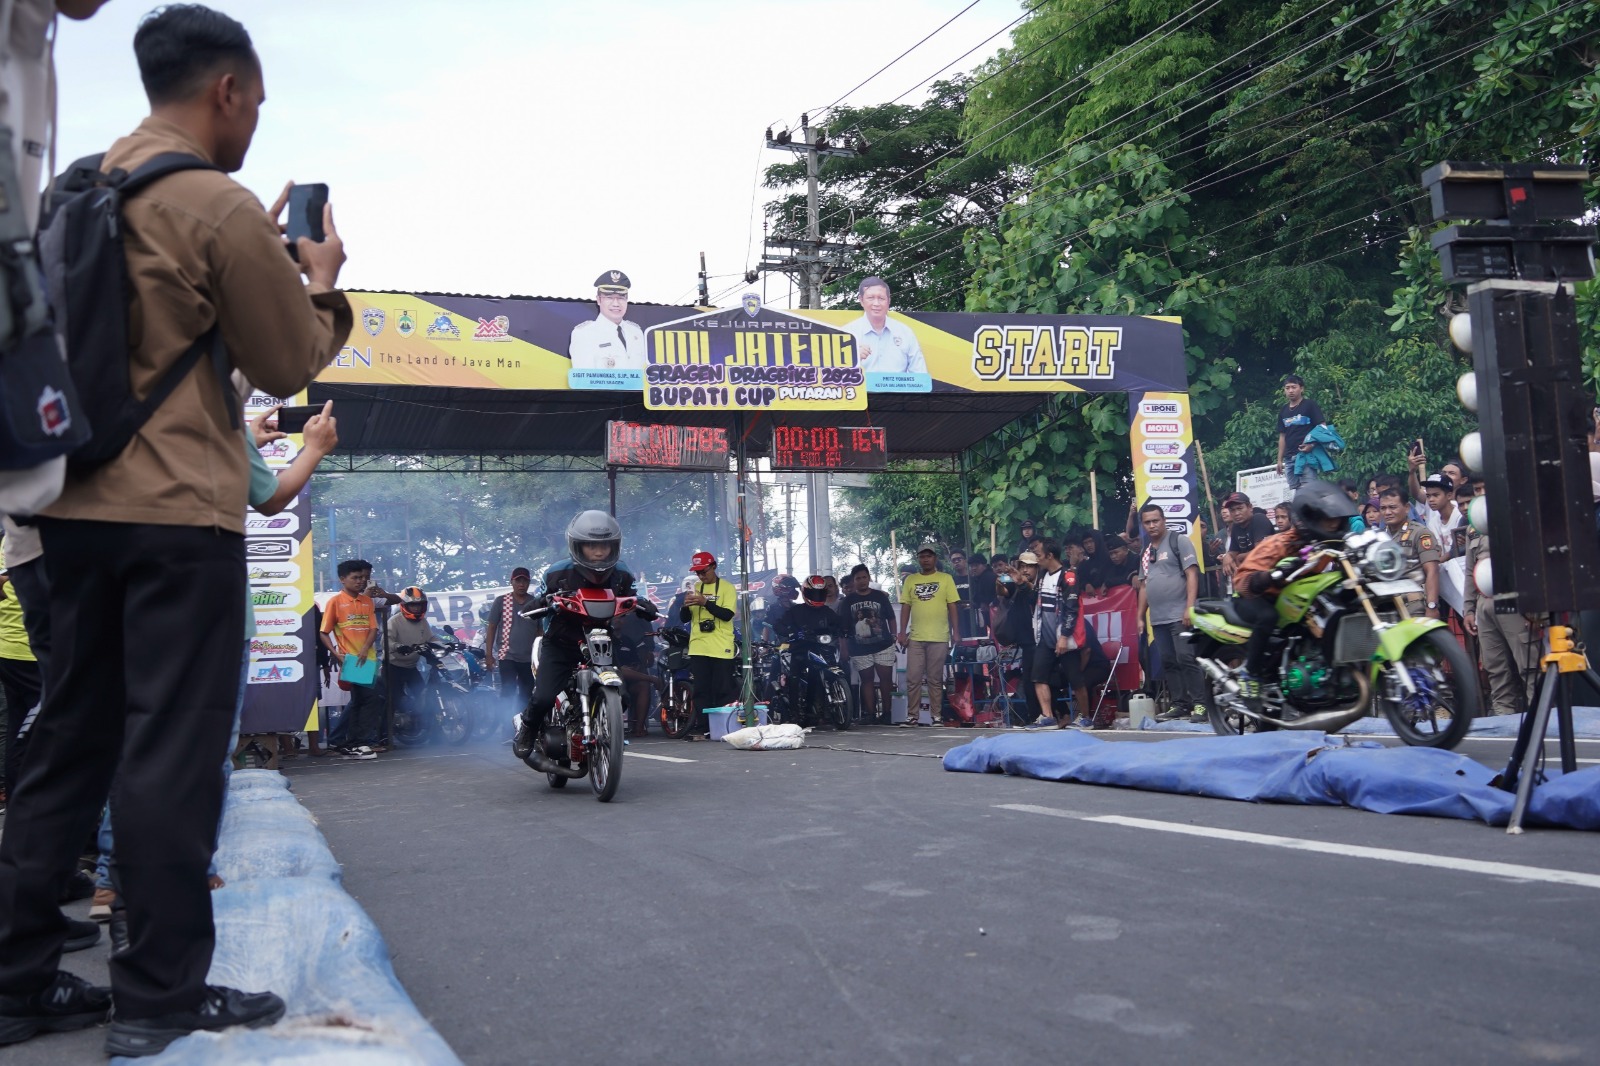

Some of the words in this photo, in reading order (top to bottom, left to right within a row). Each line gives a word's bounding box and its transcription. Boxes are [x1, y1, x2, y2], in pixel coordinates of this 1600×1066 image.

[724, 331, 853, 368] JATENG
[971, 325, 1123, 380] START
[379, 353, 401, 363] The
[408, 354, 438, 365] Land
[444, 356, 456, 366] of
[462, 356, 491, 368] Java
[497, 358, 521, 368] Man
[645, 363, 724, 385] SRAGEN
[821, 367, 865, 385] 2025
[251, 397, 287, 406] IPONE
[648, 386, 729, 408] BUPATI
[734, 386, 776, 408] CUP
[778, 386, 842, 401] PUTARAN
[845, 387, 856, 400] 3
[1146, 424, 1178, 432] MOTUL
[1255, 473, 1273, 483] TANAH
